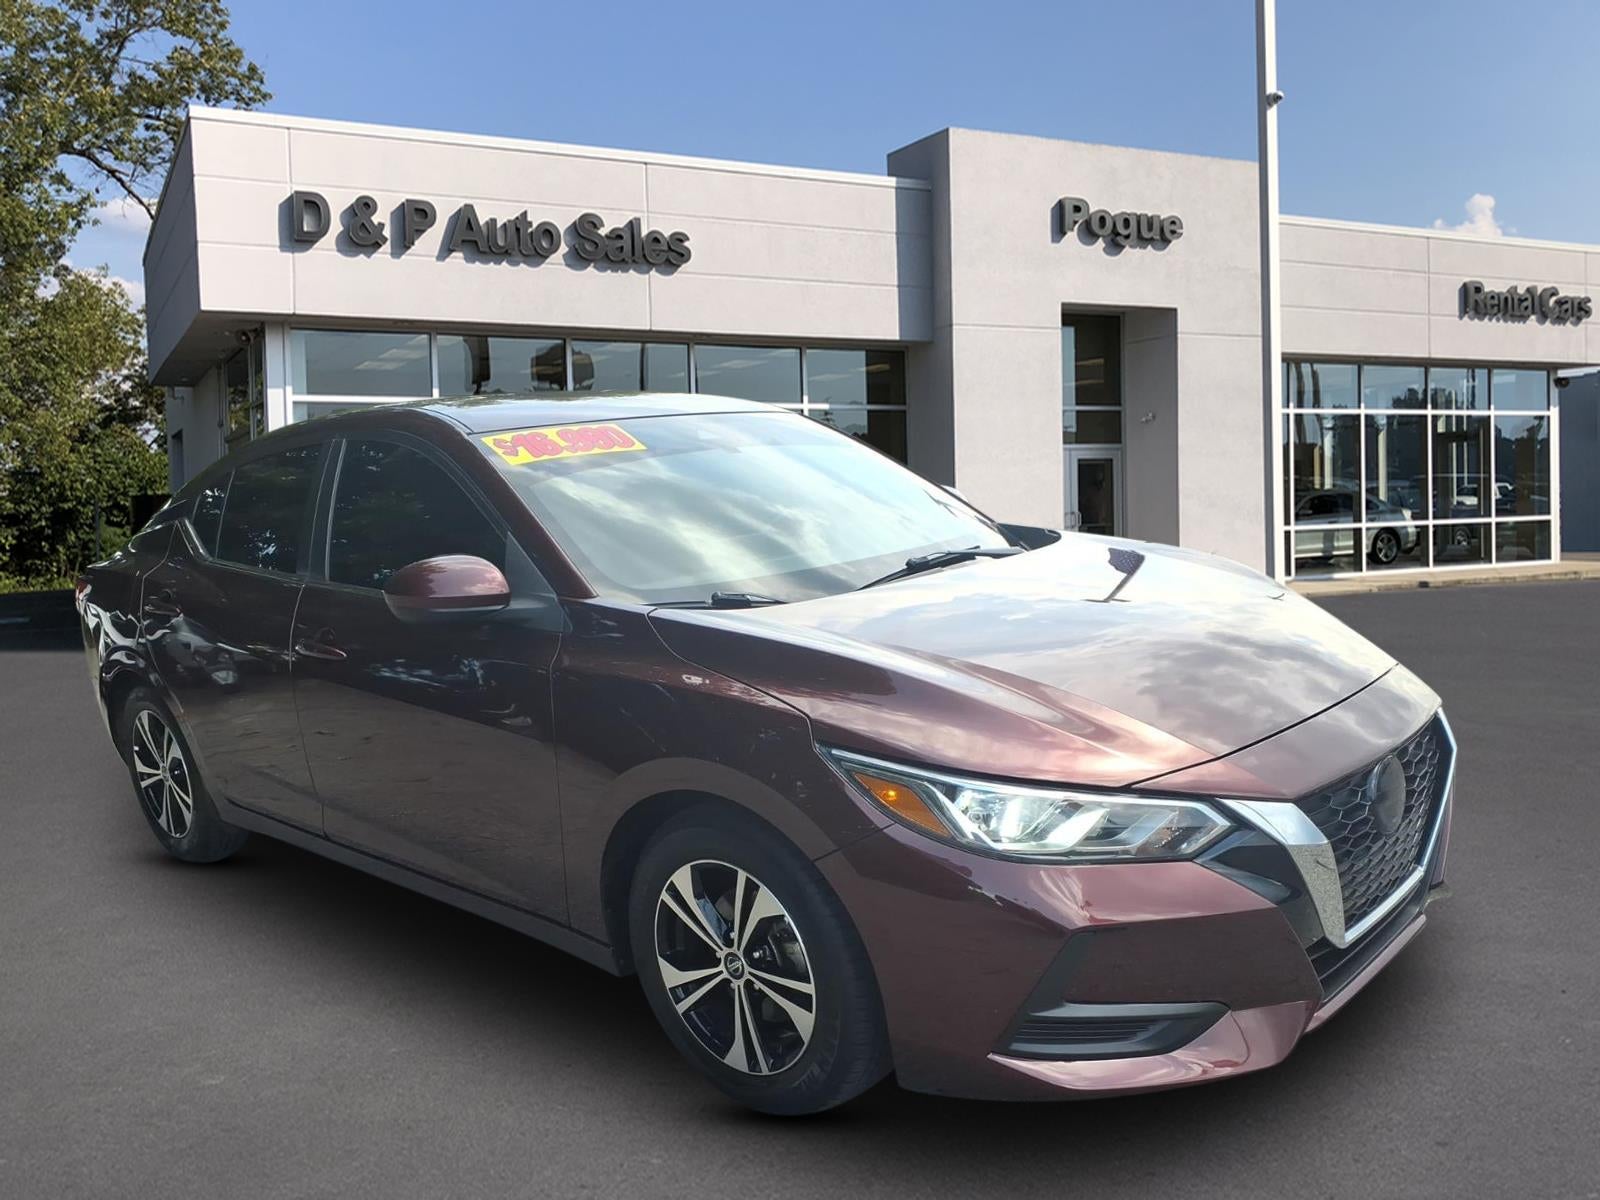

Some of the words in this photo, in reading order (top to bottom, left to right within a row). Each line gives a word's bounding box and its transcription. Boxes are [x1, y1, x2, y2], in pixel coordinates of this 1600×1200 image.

[290, 190, 331, 248] D
[344, 195, 388, 250] &
[400, 199, 437, 251] P
[447, 204, 562, 261] Auto
[570, 212, 692, 270] Sales
[1057, 196, 1184, 249] Pogue
[1461, 280, 1538, 319] Rental
[1538, 286, 1593, 322] Cars
